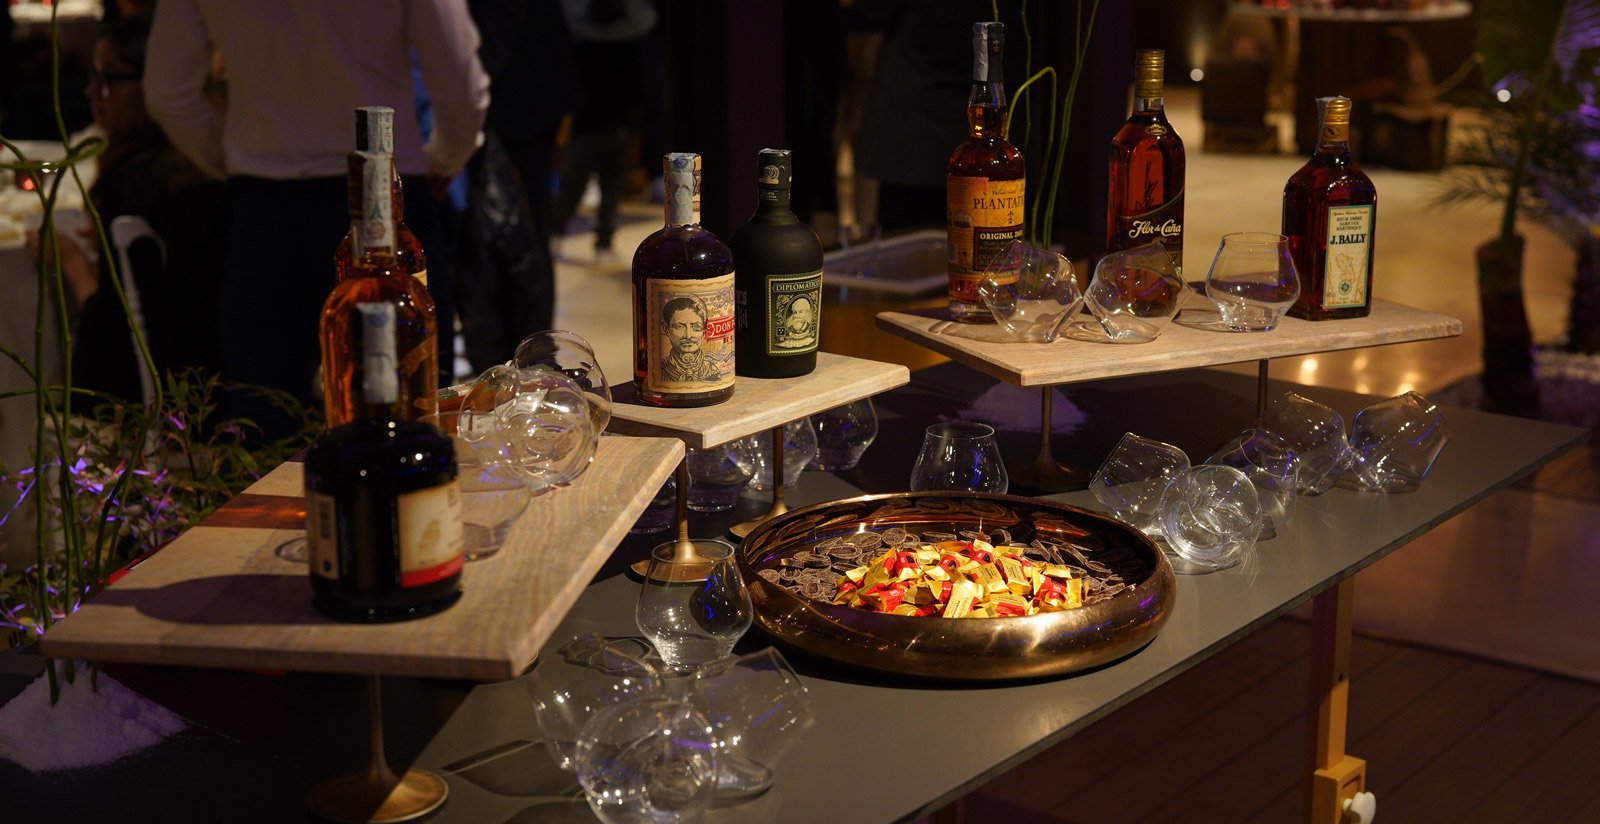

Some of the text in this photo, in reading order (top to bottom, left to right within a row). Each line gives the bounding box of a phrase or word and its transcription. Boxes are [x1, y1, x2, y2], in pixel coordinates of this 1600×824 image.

[1128, 220, 1154, 239] Flor
[1160, 218, 1182, 237] Caña
[980, 231, 1013, 240] ORIGINAL
[715, 321, 731, 334] DON
